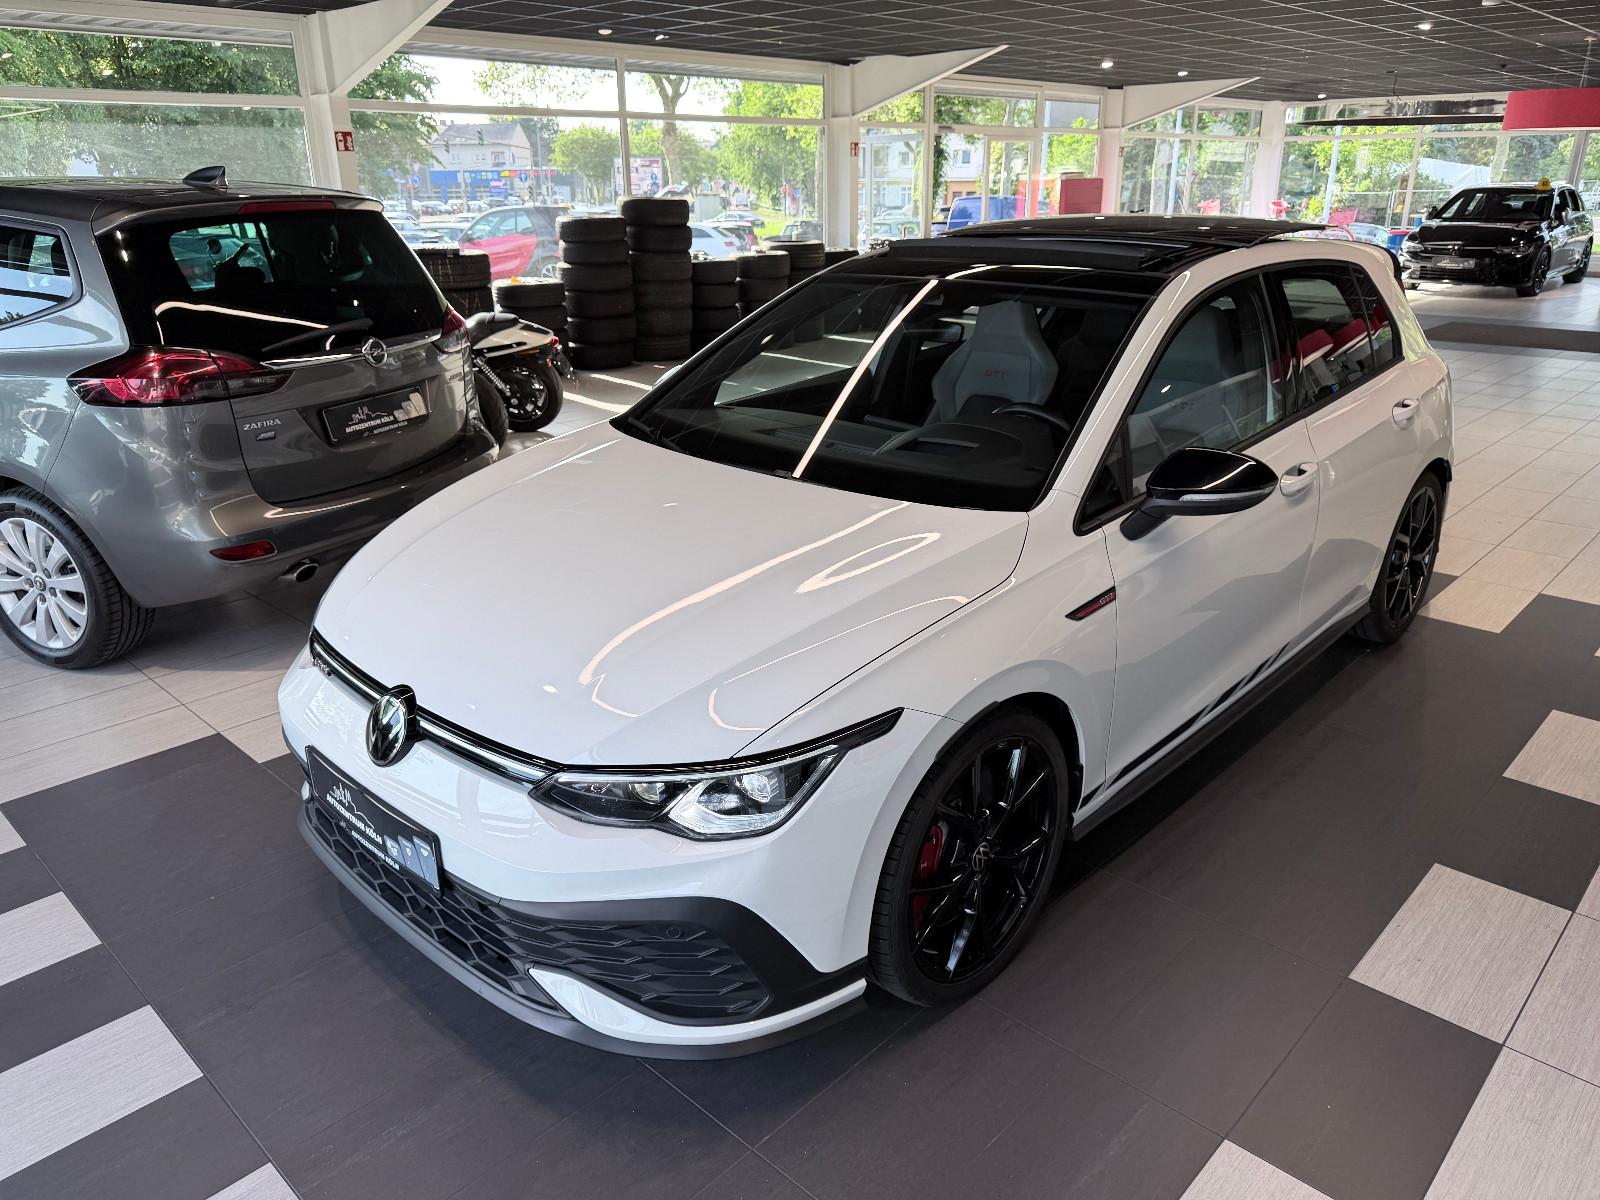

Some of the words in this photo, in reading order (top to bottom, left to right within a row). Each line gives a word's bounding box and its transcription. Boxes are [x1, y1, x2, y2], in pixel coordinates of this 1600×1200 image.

[243, 418, 282, 431] ZAFIRA
[345, 420, 382, 433] AUTOZENTRUM
[381, 415, 395, 424] KÖLN
[326, 793, 366, 832] AUTOZENTRUM
[365, 825, 383, 845] KÖLN
